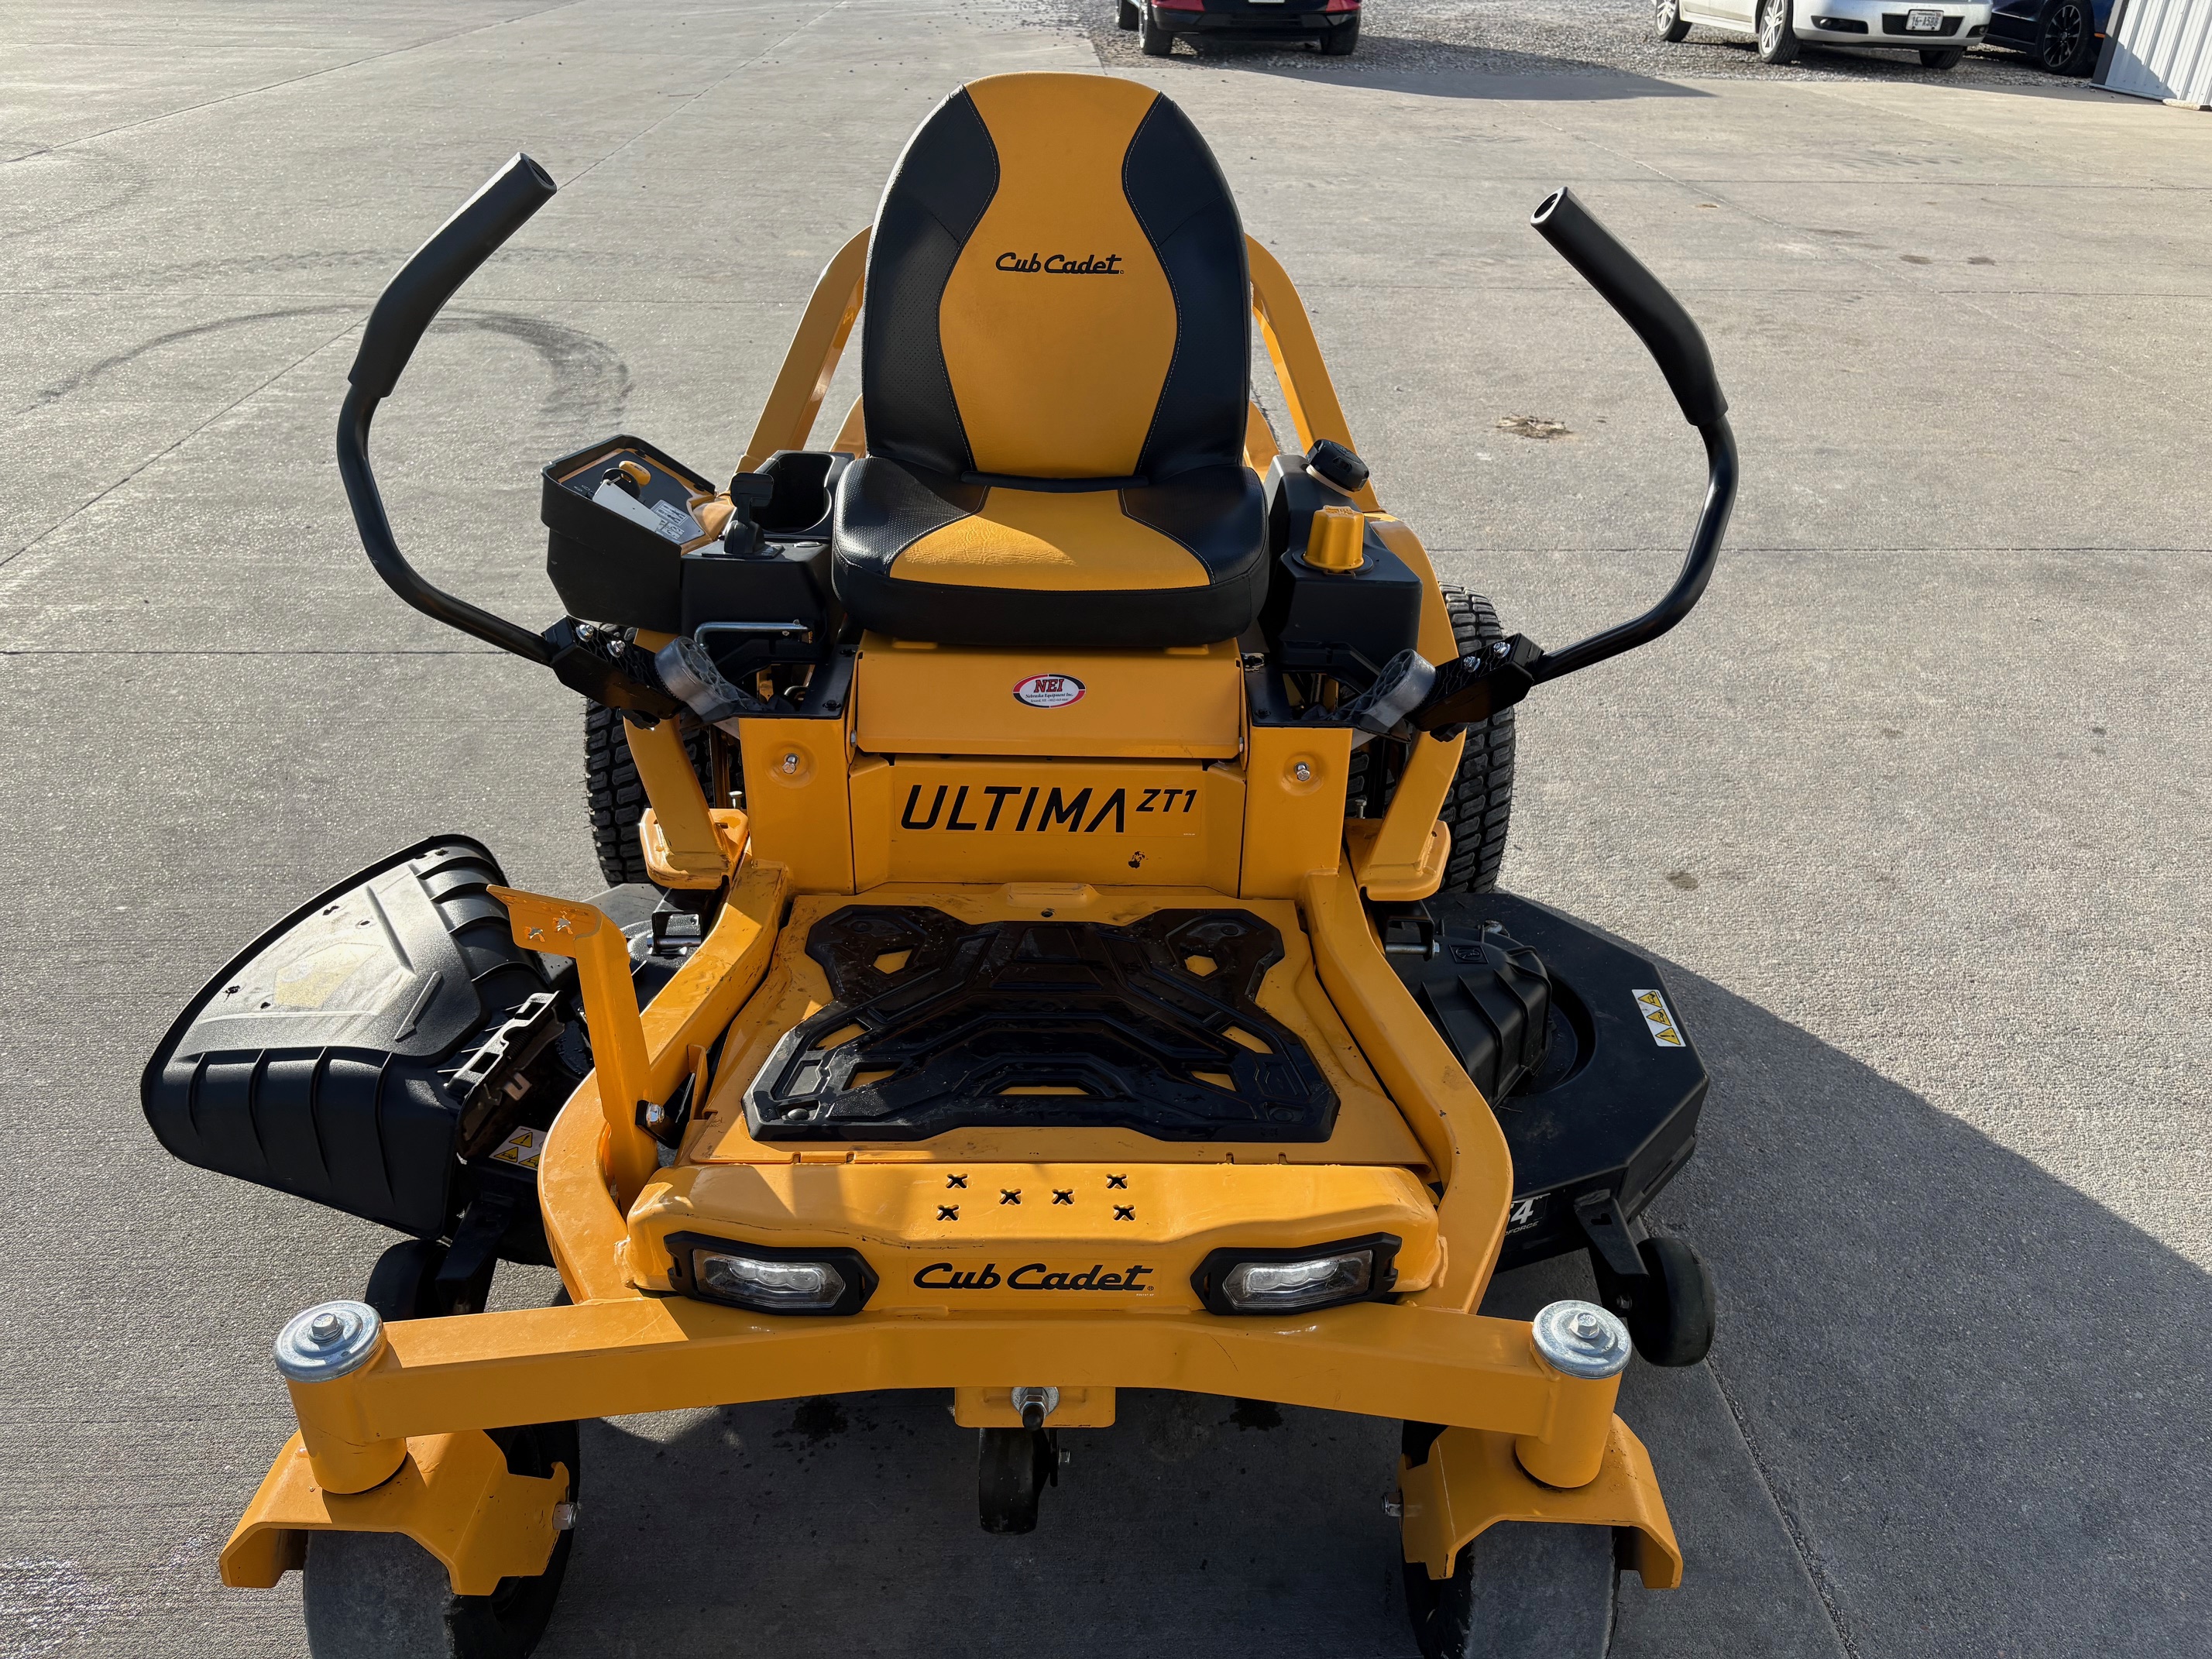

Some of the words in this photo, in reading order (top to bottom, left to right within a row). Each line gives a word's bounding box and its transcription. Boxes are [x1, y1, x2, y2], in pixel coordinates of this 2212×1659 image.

[995, 252, 1041, 273] Cub
[1044, 254, 1122, 274] Cadet
[1033, 678, 1065, 693] NEI
[901, 785, 1125, 833] ULTIMA
[1135, 788, 1197, 812] ZT1
[913, 1262, 1001, 1290] Cub
[1007, 1262, 1154, 1291] Cadet
